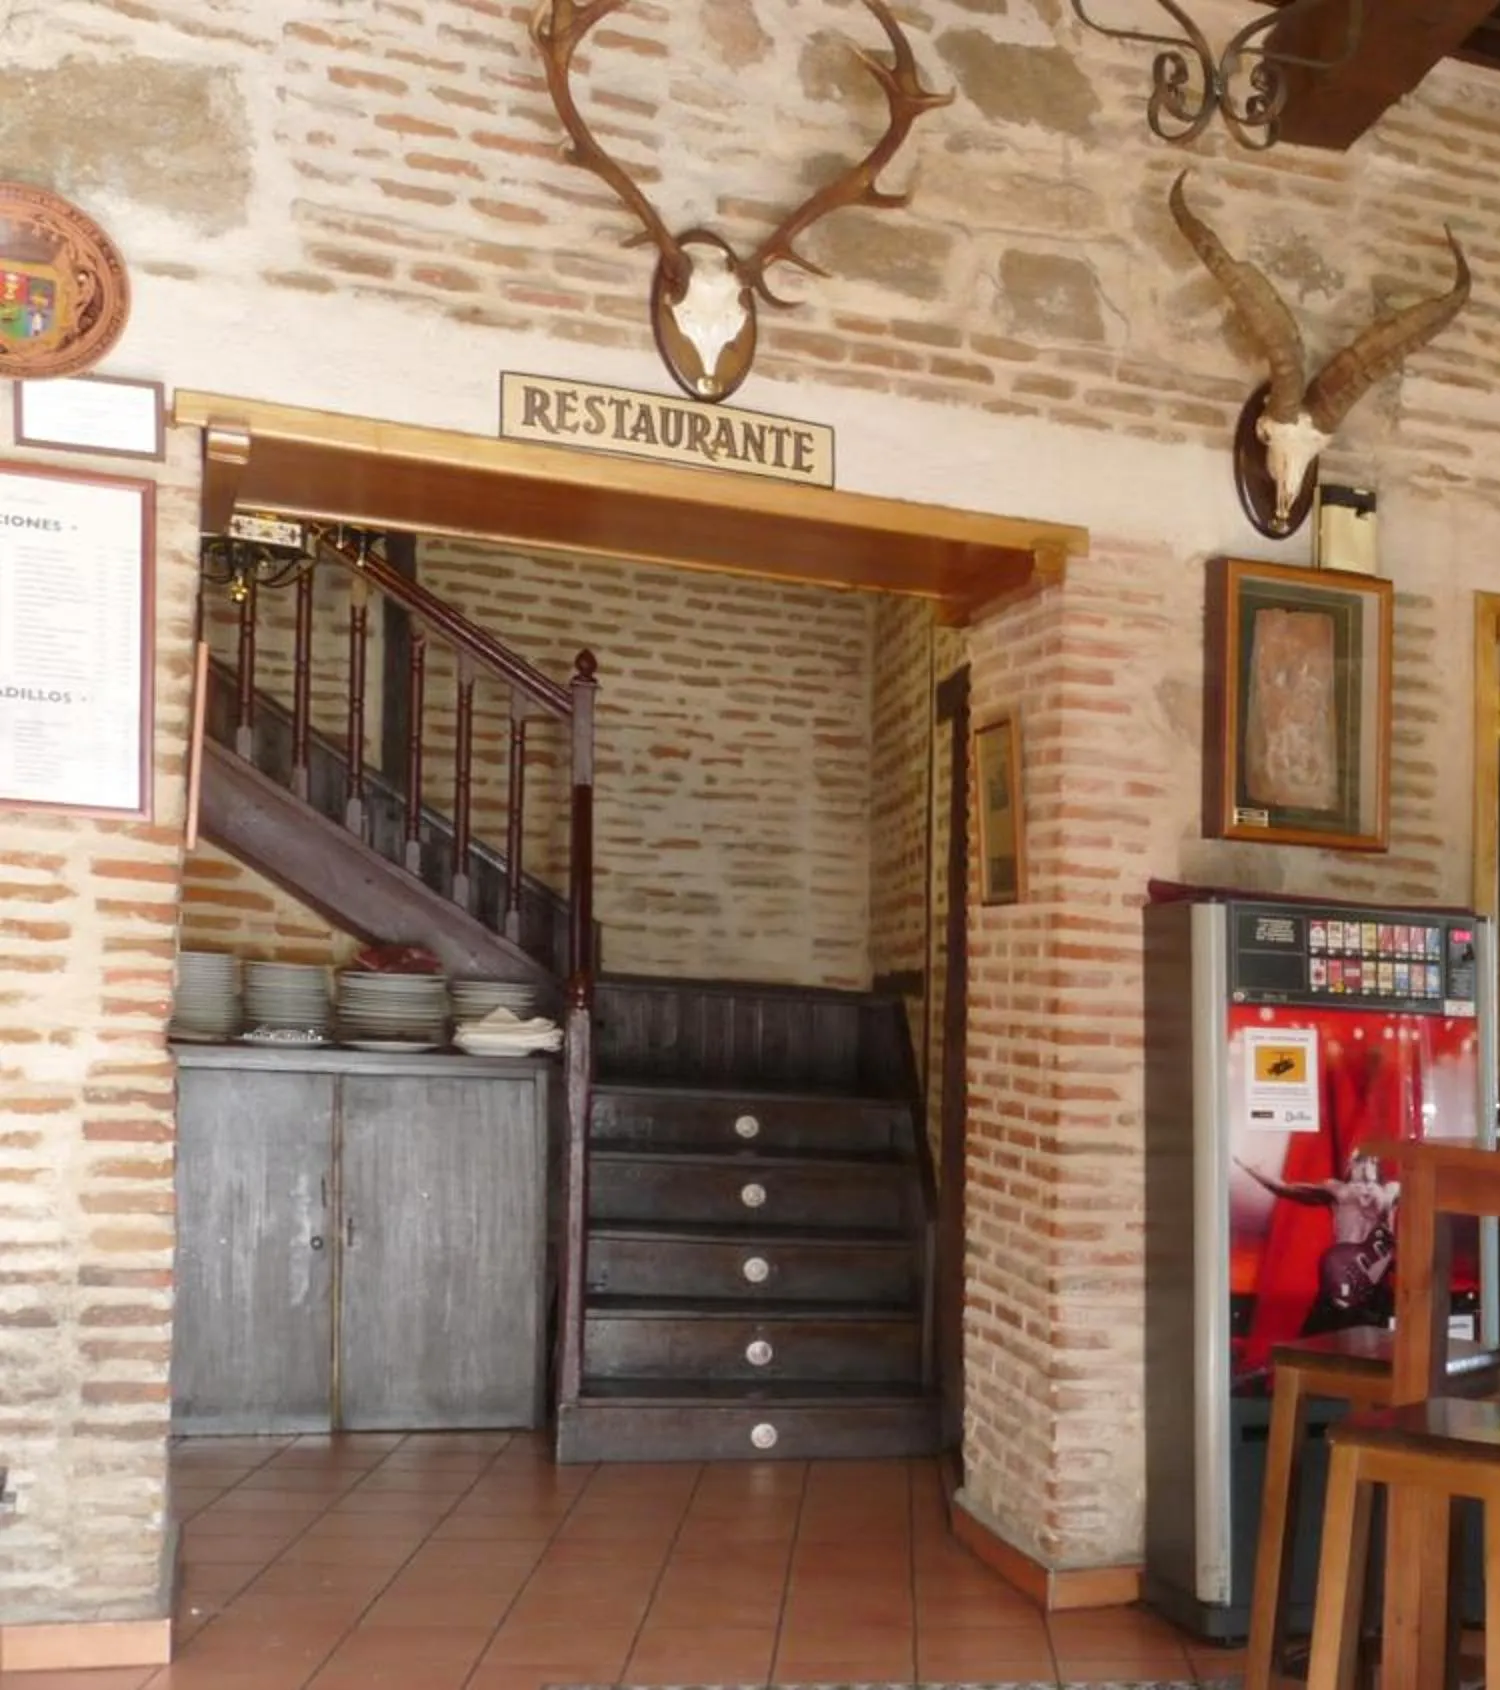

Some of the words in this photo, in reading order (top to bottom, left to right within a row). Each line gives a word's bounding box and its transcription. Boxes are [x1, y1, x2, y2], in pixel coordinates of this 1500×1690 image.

[522, 385, 816, 474] RESTAURANTE
[0, 513, 62, 532] IONES
[0, 686, 72, 704] DILLOS
